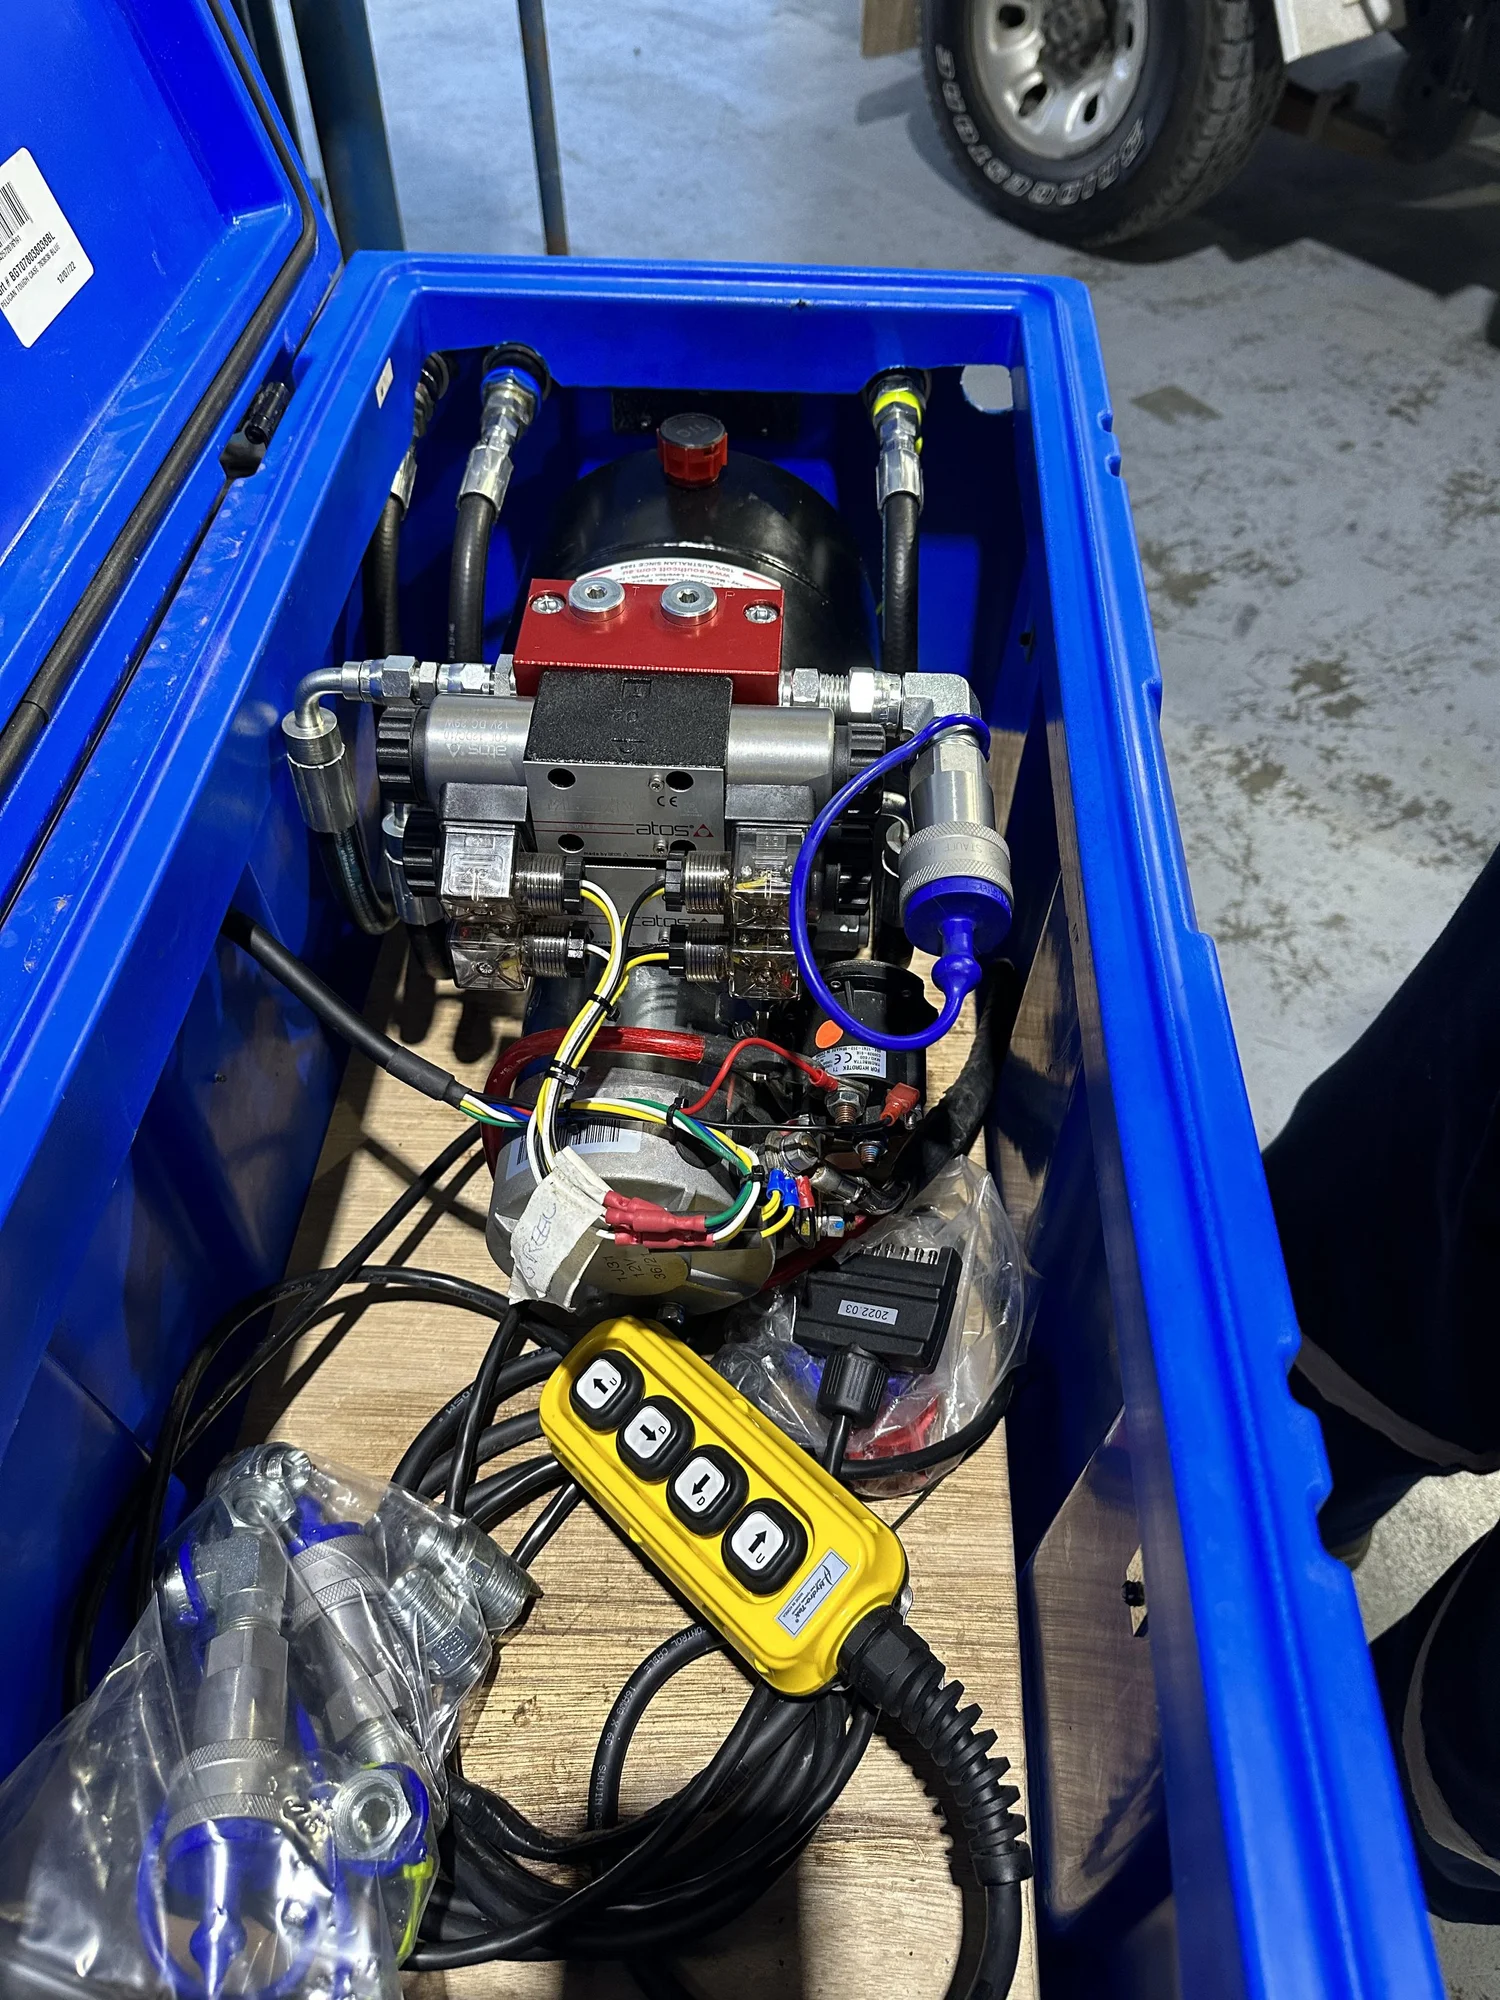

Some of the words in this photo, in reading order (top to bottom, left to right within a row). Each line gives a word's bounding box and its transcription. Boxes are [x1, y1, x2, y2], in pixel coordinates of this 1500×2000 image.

[0, 288, 17, 309] PELICAN
[15, 275, 30, 292] TOUGH
[27, 265, 40, 279] CASE
[49, 242, 61, 257] BLUE
[622, 566, 731, 578] www.southcott.com.au
[664, 561, 714, 569] AUSTRALIAN
[471, 719, 487, 729] DC
[468, 744, 507, 759] atos
[636, 821, 691, 837] atos
[623, 1258, 645, 1279] 12V
[845, 1303, 890, 1321] 2022.03
[609, 1377, 618, 1387] U
[658, 1425, 667, 1436] D
[696, 1496, 705, 1506] D
[756, 1554, 765, 1564] U
[643, 1648, 669, 1674] CABLE
[616, 1685, 637, 1716] 16AWG
[594, 1764, 607, 1806] SUNJIN
